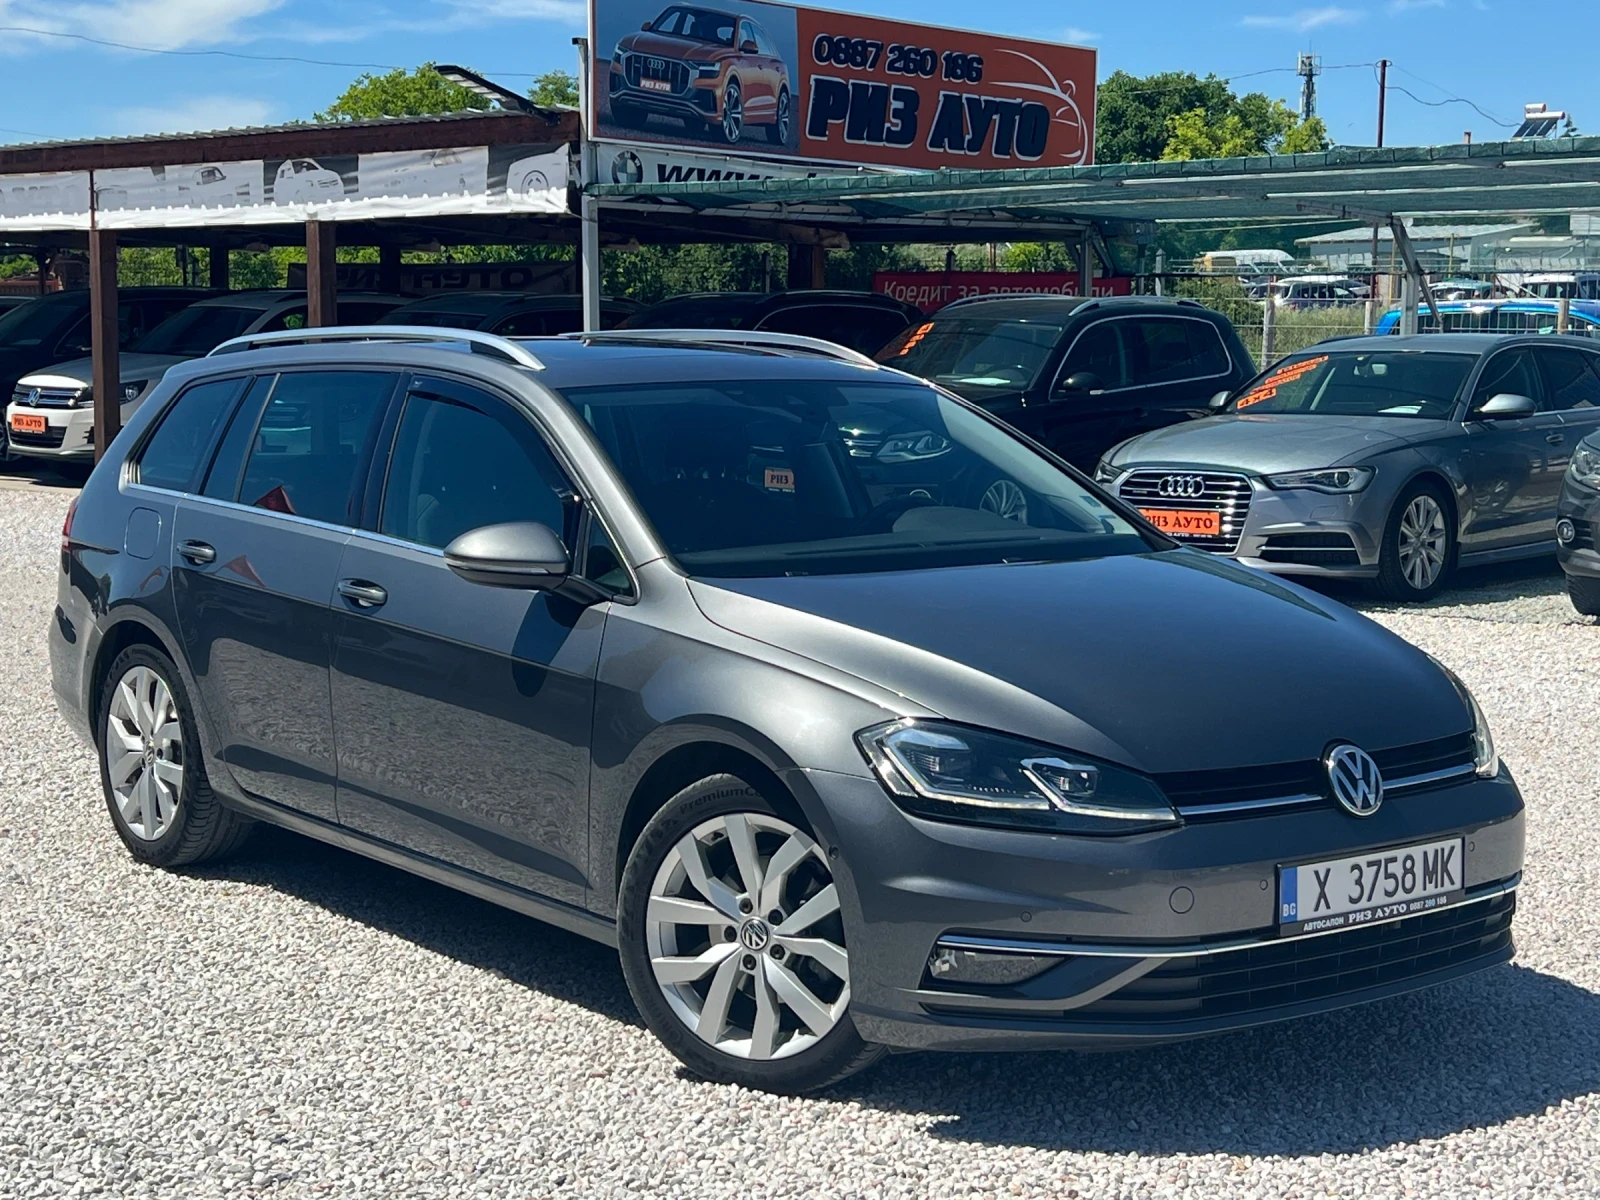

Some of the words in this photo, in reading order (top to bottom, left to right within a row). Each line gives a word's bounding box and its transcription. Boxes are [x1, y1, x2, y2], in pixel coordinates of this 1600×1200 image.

[812, 33, 883, 71] 0887
[885, 43, 937, 78] 260
[941, 50, 984, 84] 186
[805, 74, 920, 148] РИЗ
[926, 90, 1050, 161] АУТО
[883, 281, 952, 305] Кредит
[958, 284, 980, 301] за
[1172, 516, 1213, 529] АУТО
[1313, 868, 1332, 912] X
[1348, 854, 1417, 905] 3758
[1422, 845, 1456, 892] MK
[1282, 902, 1297, 917] BG
[1303, 916, 1344, 932] АВТОСАЛОН
[1348, 907, 1372, 924] РИЗ
[1375, 903, 1407, 918] АУТО
